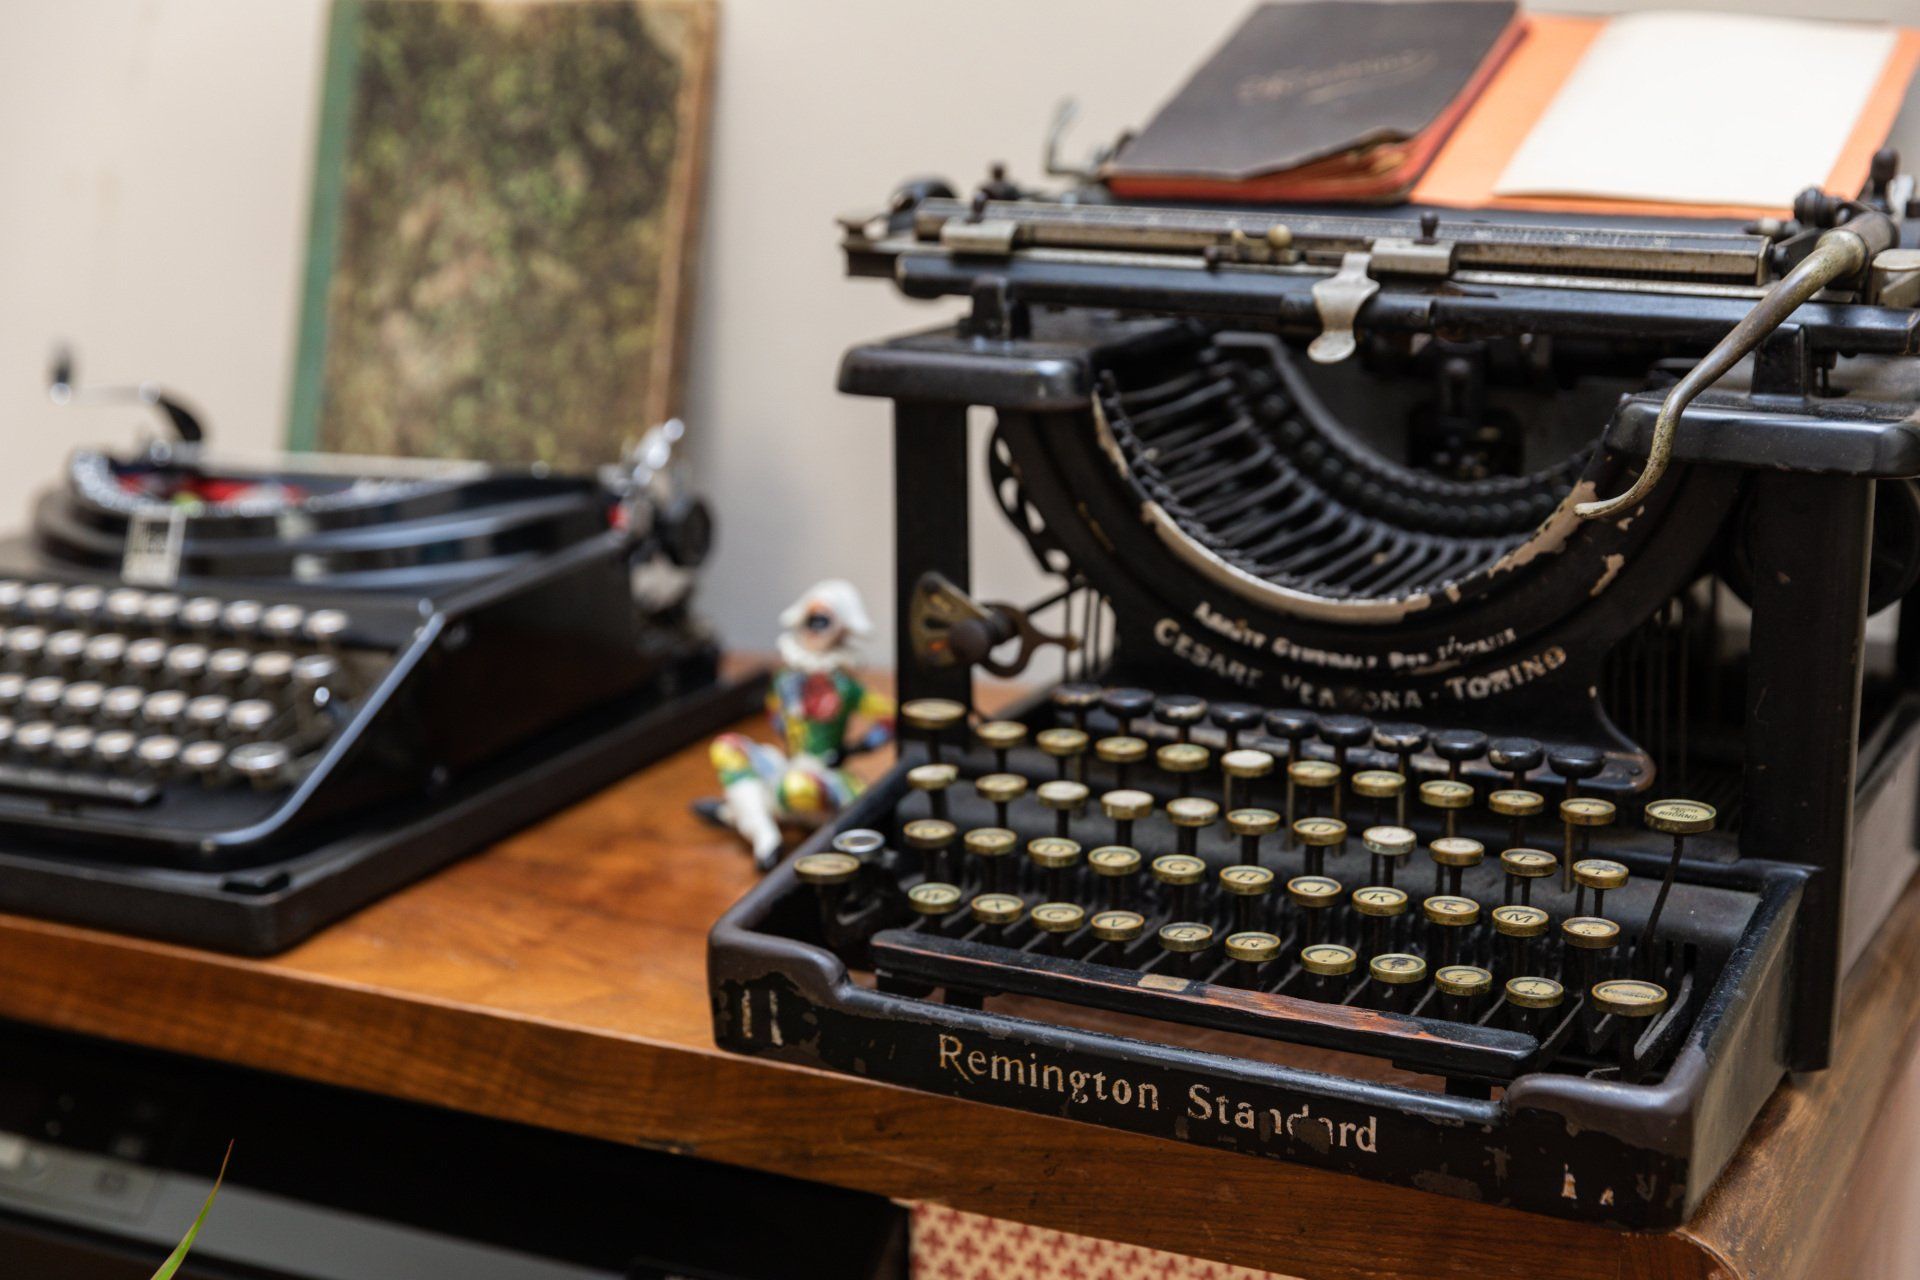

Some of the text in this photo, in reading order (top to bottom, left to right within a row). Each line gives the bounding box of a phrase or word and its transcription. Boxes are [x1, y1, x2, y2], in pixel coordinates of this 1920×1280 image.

[1154, 618, 1263, 688] CESARE
[1444, 646, 1567, 700] TORINO
[1168, 860, 1190, 872] G
[1236, 872, 1258, 881] H
[1368, 893, 1391, 903] K
[1506, 913, 1535, 924] M
[940, 1034, 1160, 1111] Remington
